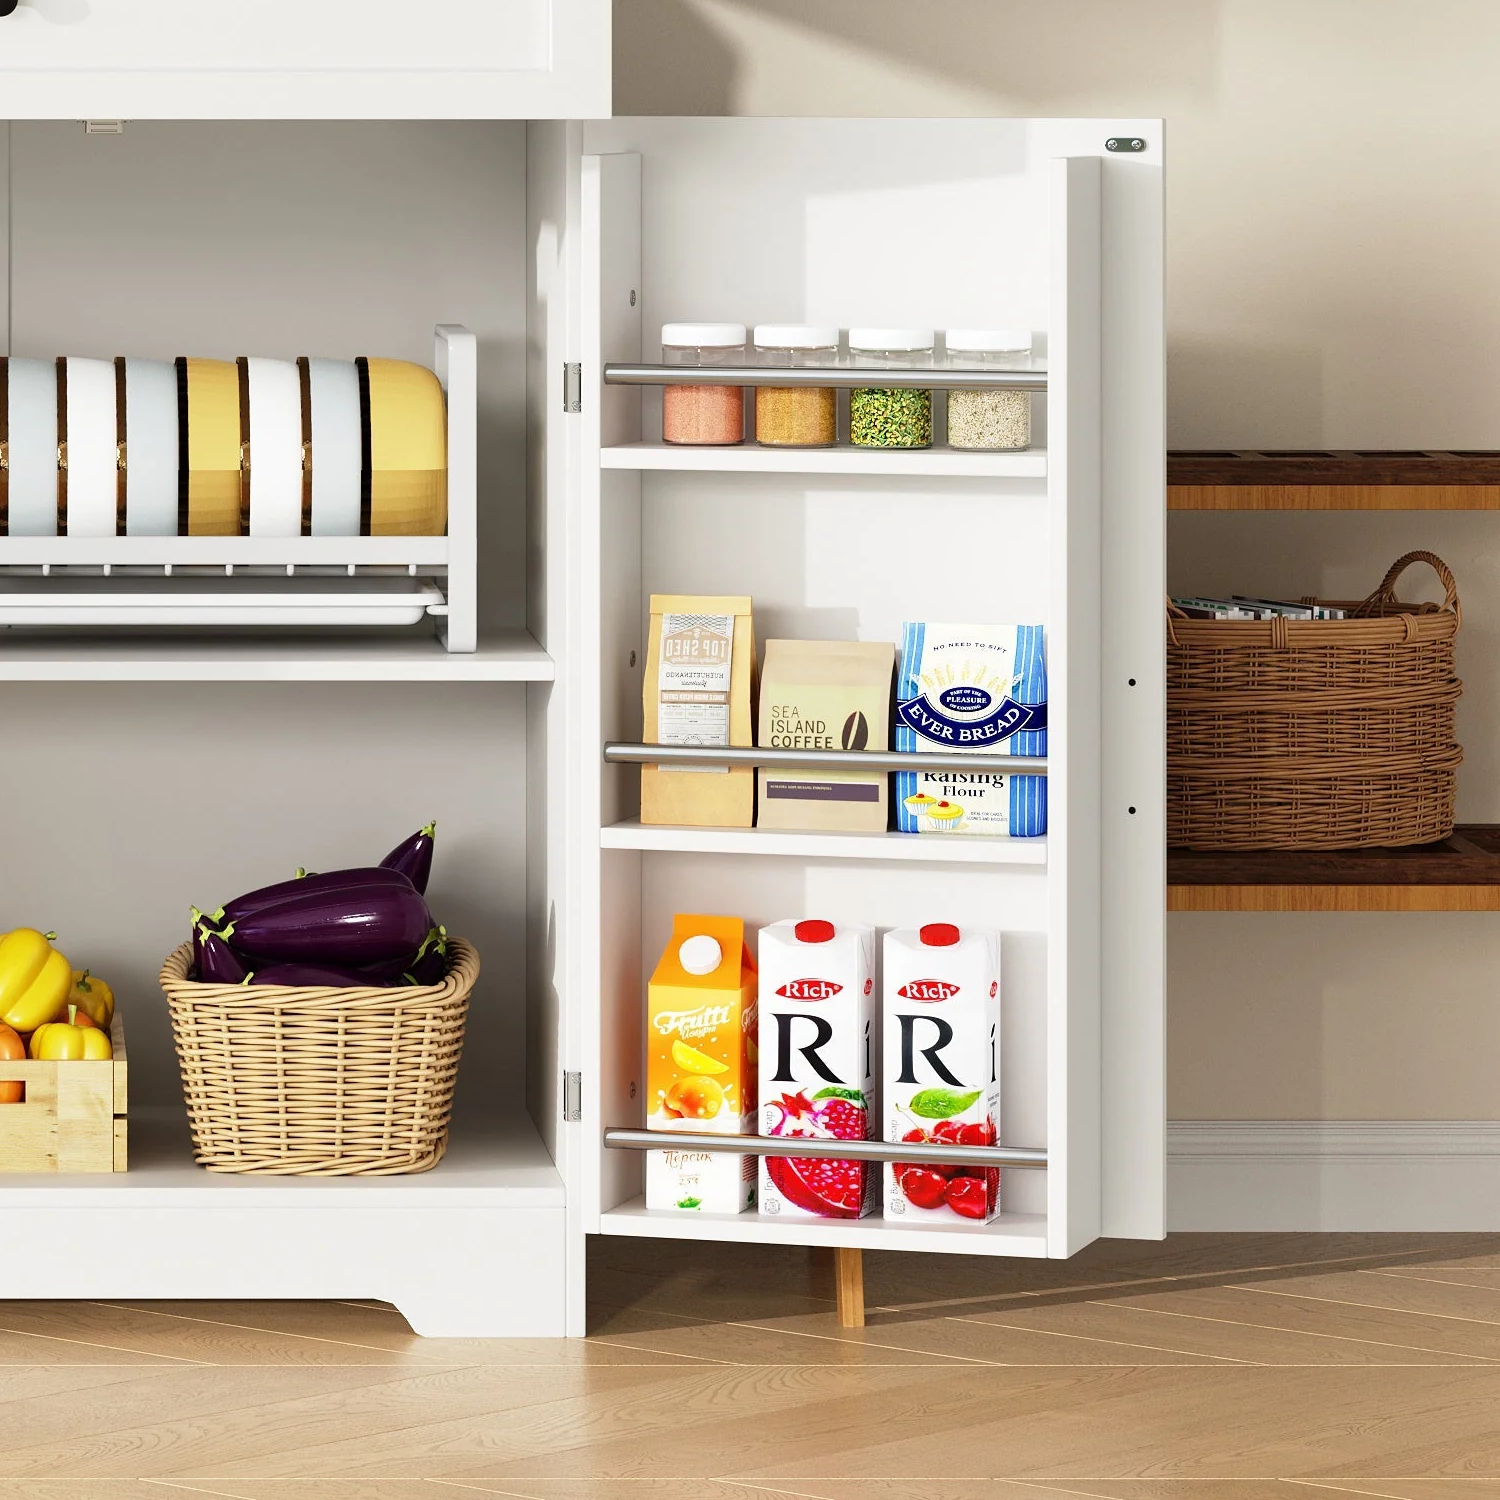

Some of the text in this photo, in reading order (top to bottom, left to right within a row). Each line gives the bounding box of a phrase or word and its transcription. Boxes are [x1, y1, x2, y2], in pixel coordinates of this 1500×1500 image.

[988, 644, 1007, 654] SIFT
[946, 696, 987, 704] PLEASURE
[772, 706, 800, 718] SEA
[771, 720, 826, 734] ISLAND
[908, 704, 1020, 741] EVER BREAD
[771, 736, 833, 749] COFFEE
[944, 786, 986, 798] Flour
[785, 982, 834, 998] Rich
[906, 982, 952, 999] Rich
[654, 1005, 731, 1034] Frutti
[768, 1013, 846, 1084] R
[894, 1014, 966, 1088] R
[766, 1111, 774, 1135] ектар
[662, 1151, 712, 1169] Персик
